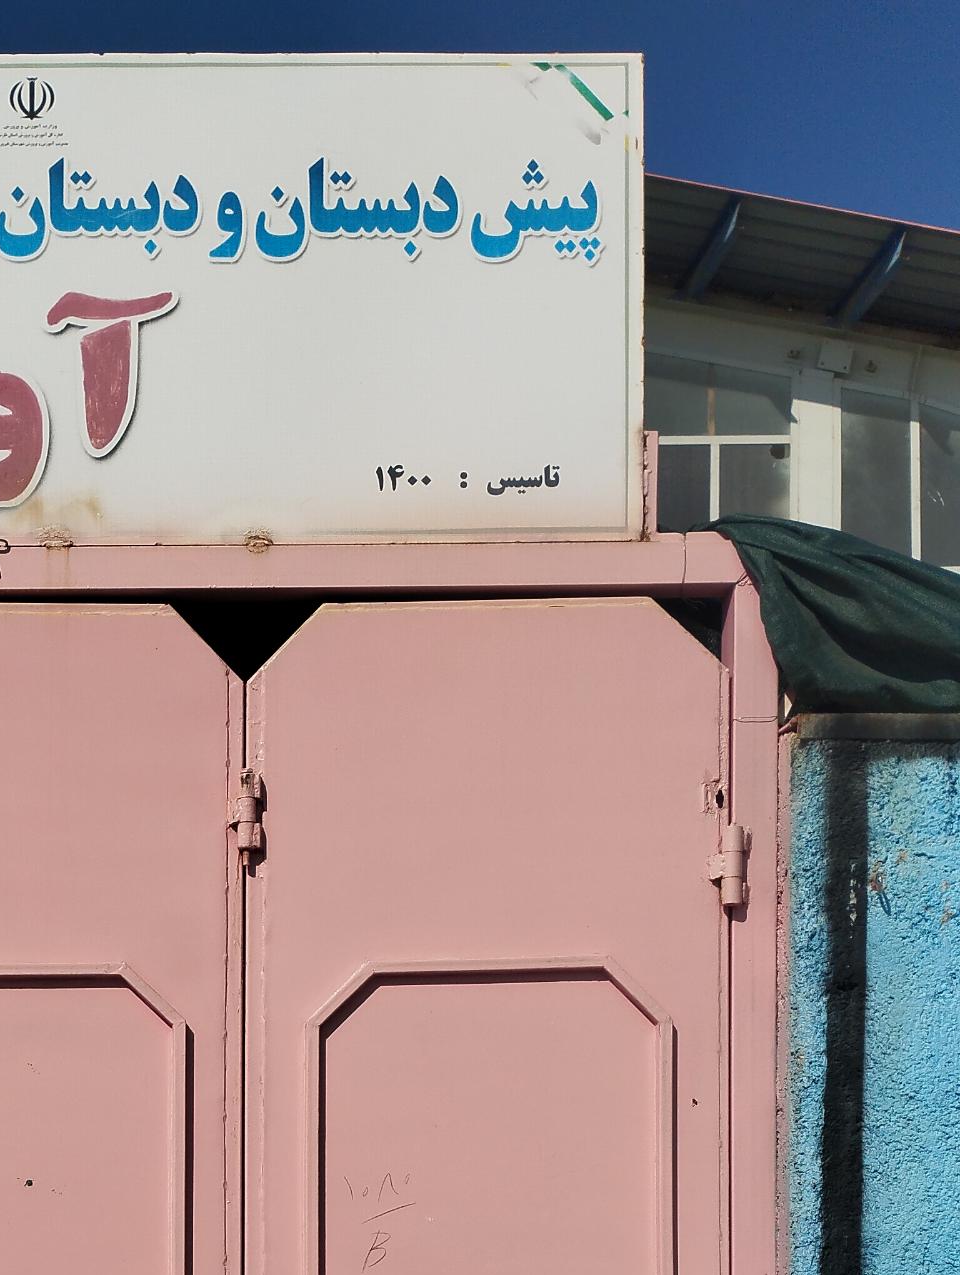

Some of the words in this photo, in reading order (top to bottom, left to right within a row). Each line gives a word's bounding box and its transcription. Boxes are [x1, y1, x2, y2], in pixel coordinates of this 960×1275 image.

[208, 190, 243, 259] و
[255, 157, 459, 260] دبستان
[470, 159, 602, 265] پیش
[374, 464, 433, 492] ۱۴۰۰
[486, 463, 561, 496] تاسیس
